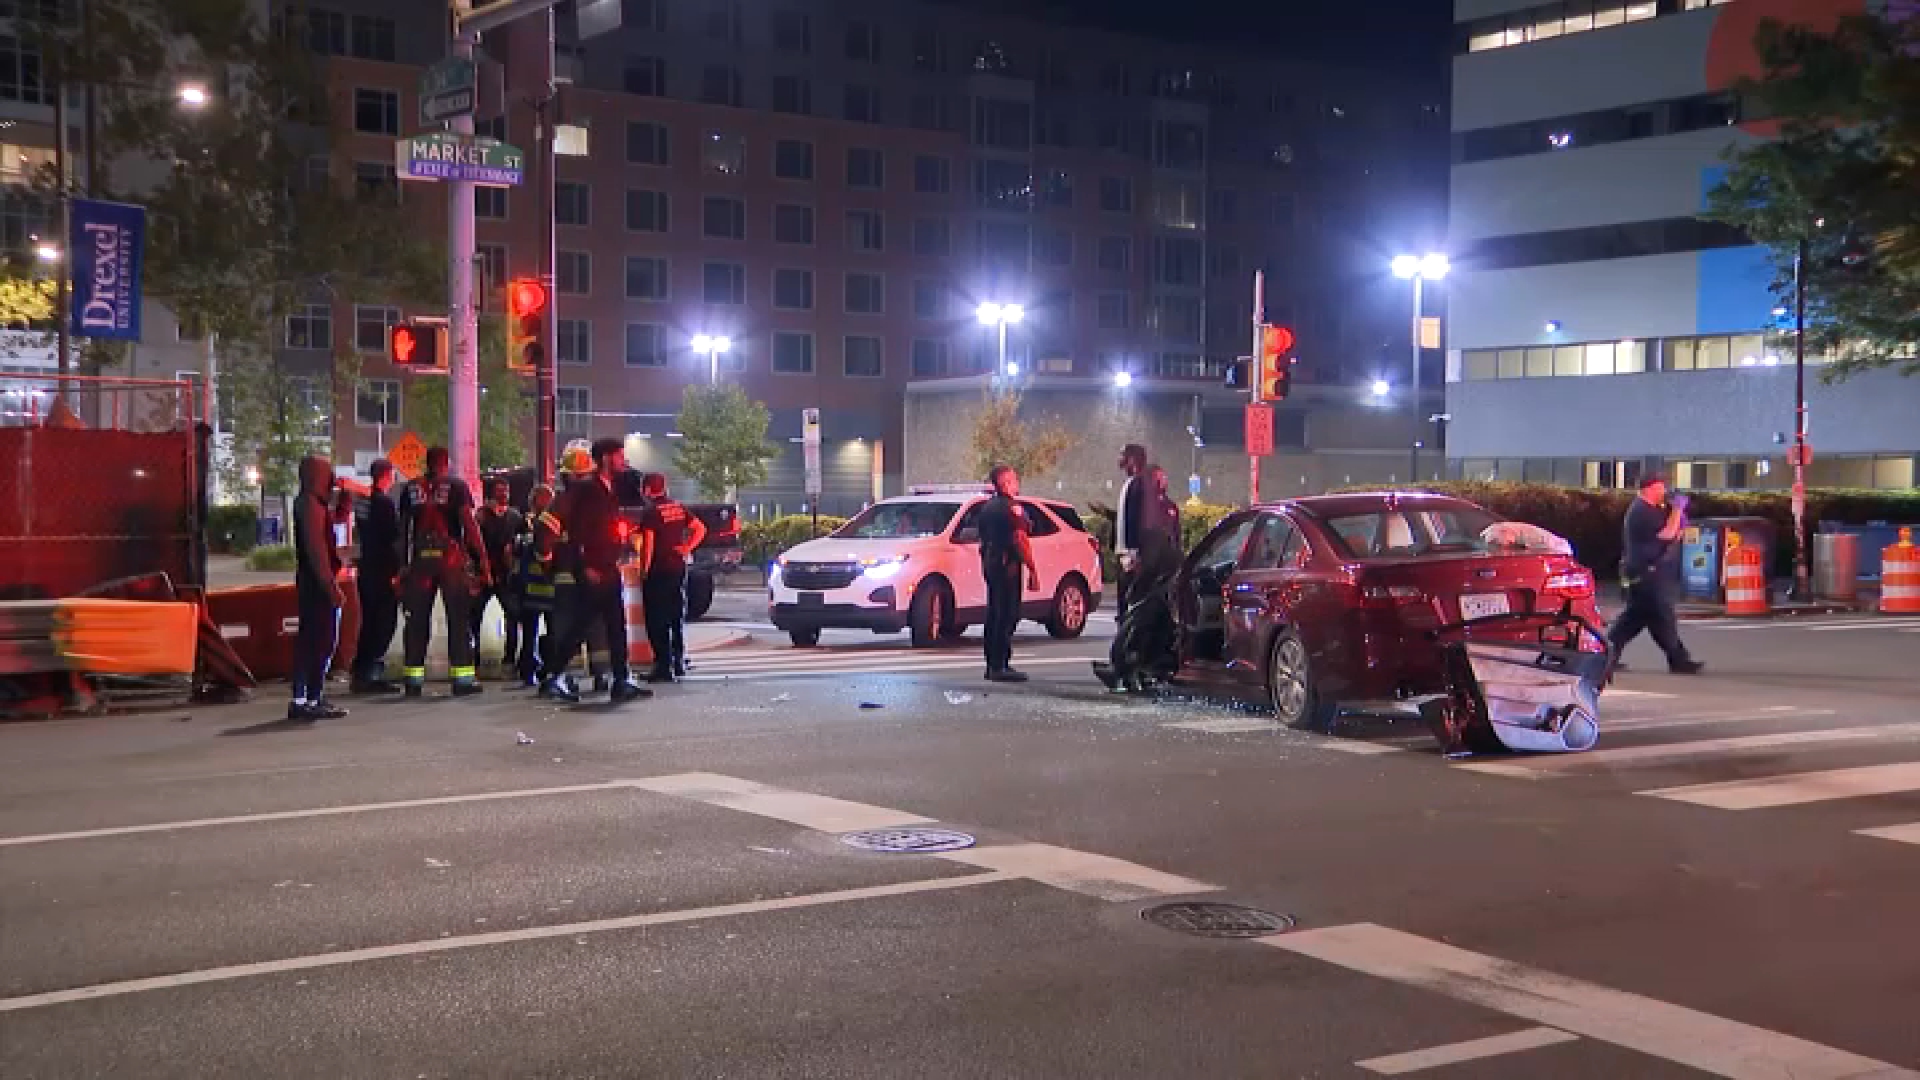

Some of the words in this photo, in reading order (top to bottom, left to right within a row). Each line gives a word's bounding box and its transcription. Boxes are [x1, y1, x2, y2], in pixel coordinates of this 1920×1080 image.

[412, 139, 490, 165] MARKET
[503, 155, 521, 169] ST
[83, 222, 118, 331] Drexel
[117, 229, 132, 329] UNIVERSITY
